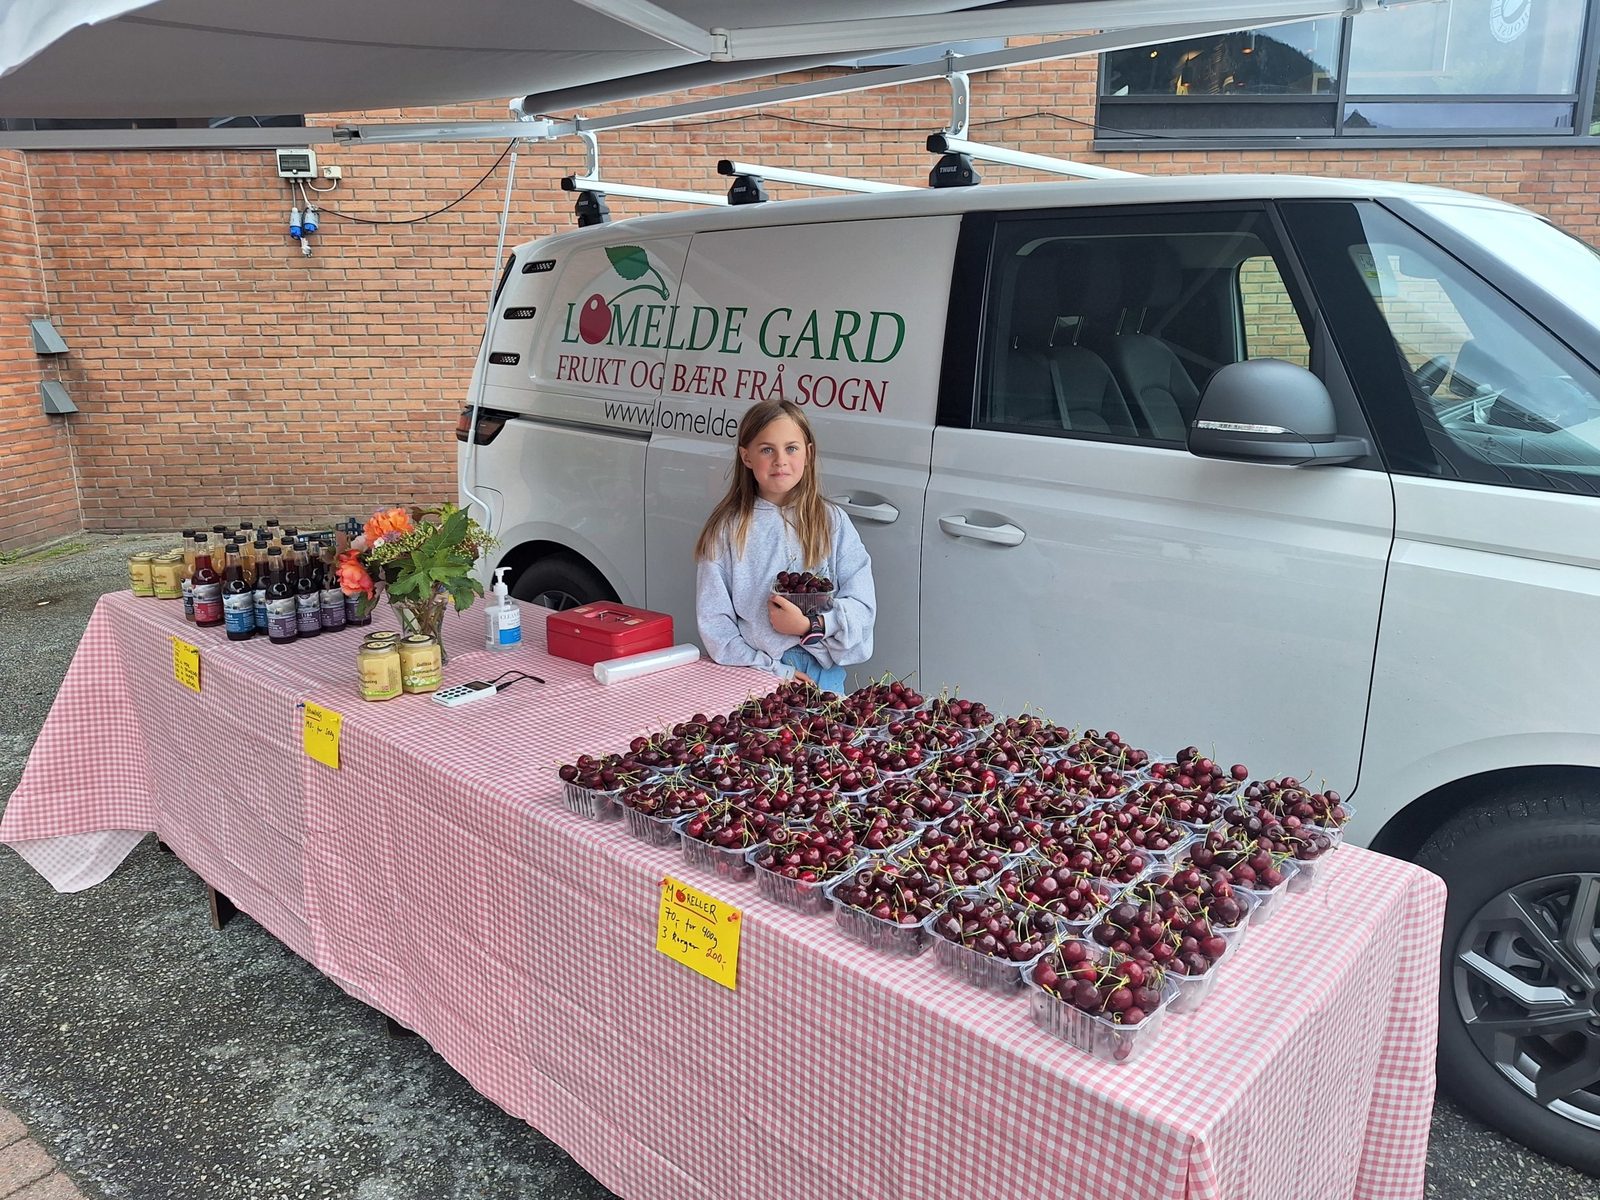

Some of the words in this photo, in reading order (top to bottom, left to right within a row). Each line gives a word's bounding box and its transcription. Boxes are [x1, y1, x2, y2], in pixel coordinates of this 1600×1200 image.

[939, 165, 957, 173] THULE
[561, 294, 748, 354] LOMELDE
[758, 307, 906, 364] GARD
[555, 354, 626, 384] FRUKT
[630, 360, 666, 391] OG
[670, 363, 727, 397] BÆR
[733, 363, 786, 401] FRÅ
[794, 374, 890, 414] SOGN
[665, 884, 718, 924] MORELLER
[662, 926, 668, 939] 3
[685, 918, 697, 932] for
[702, 926, 718, 949] 400g
